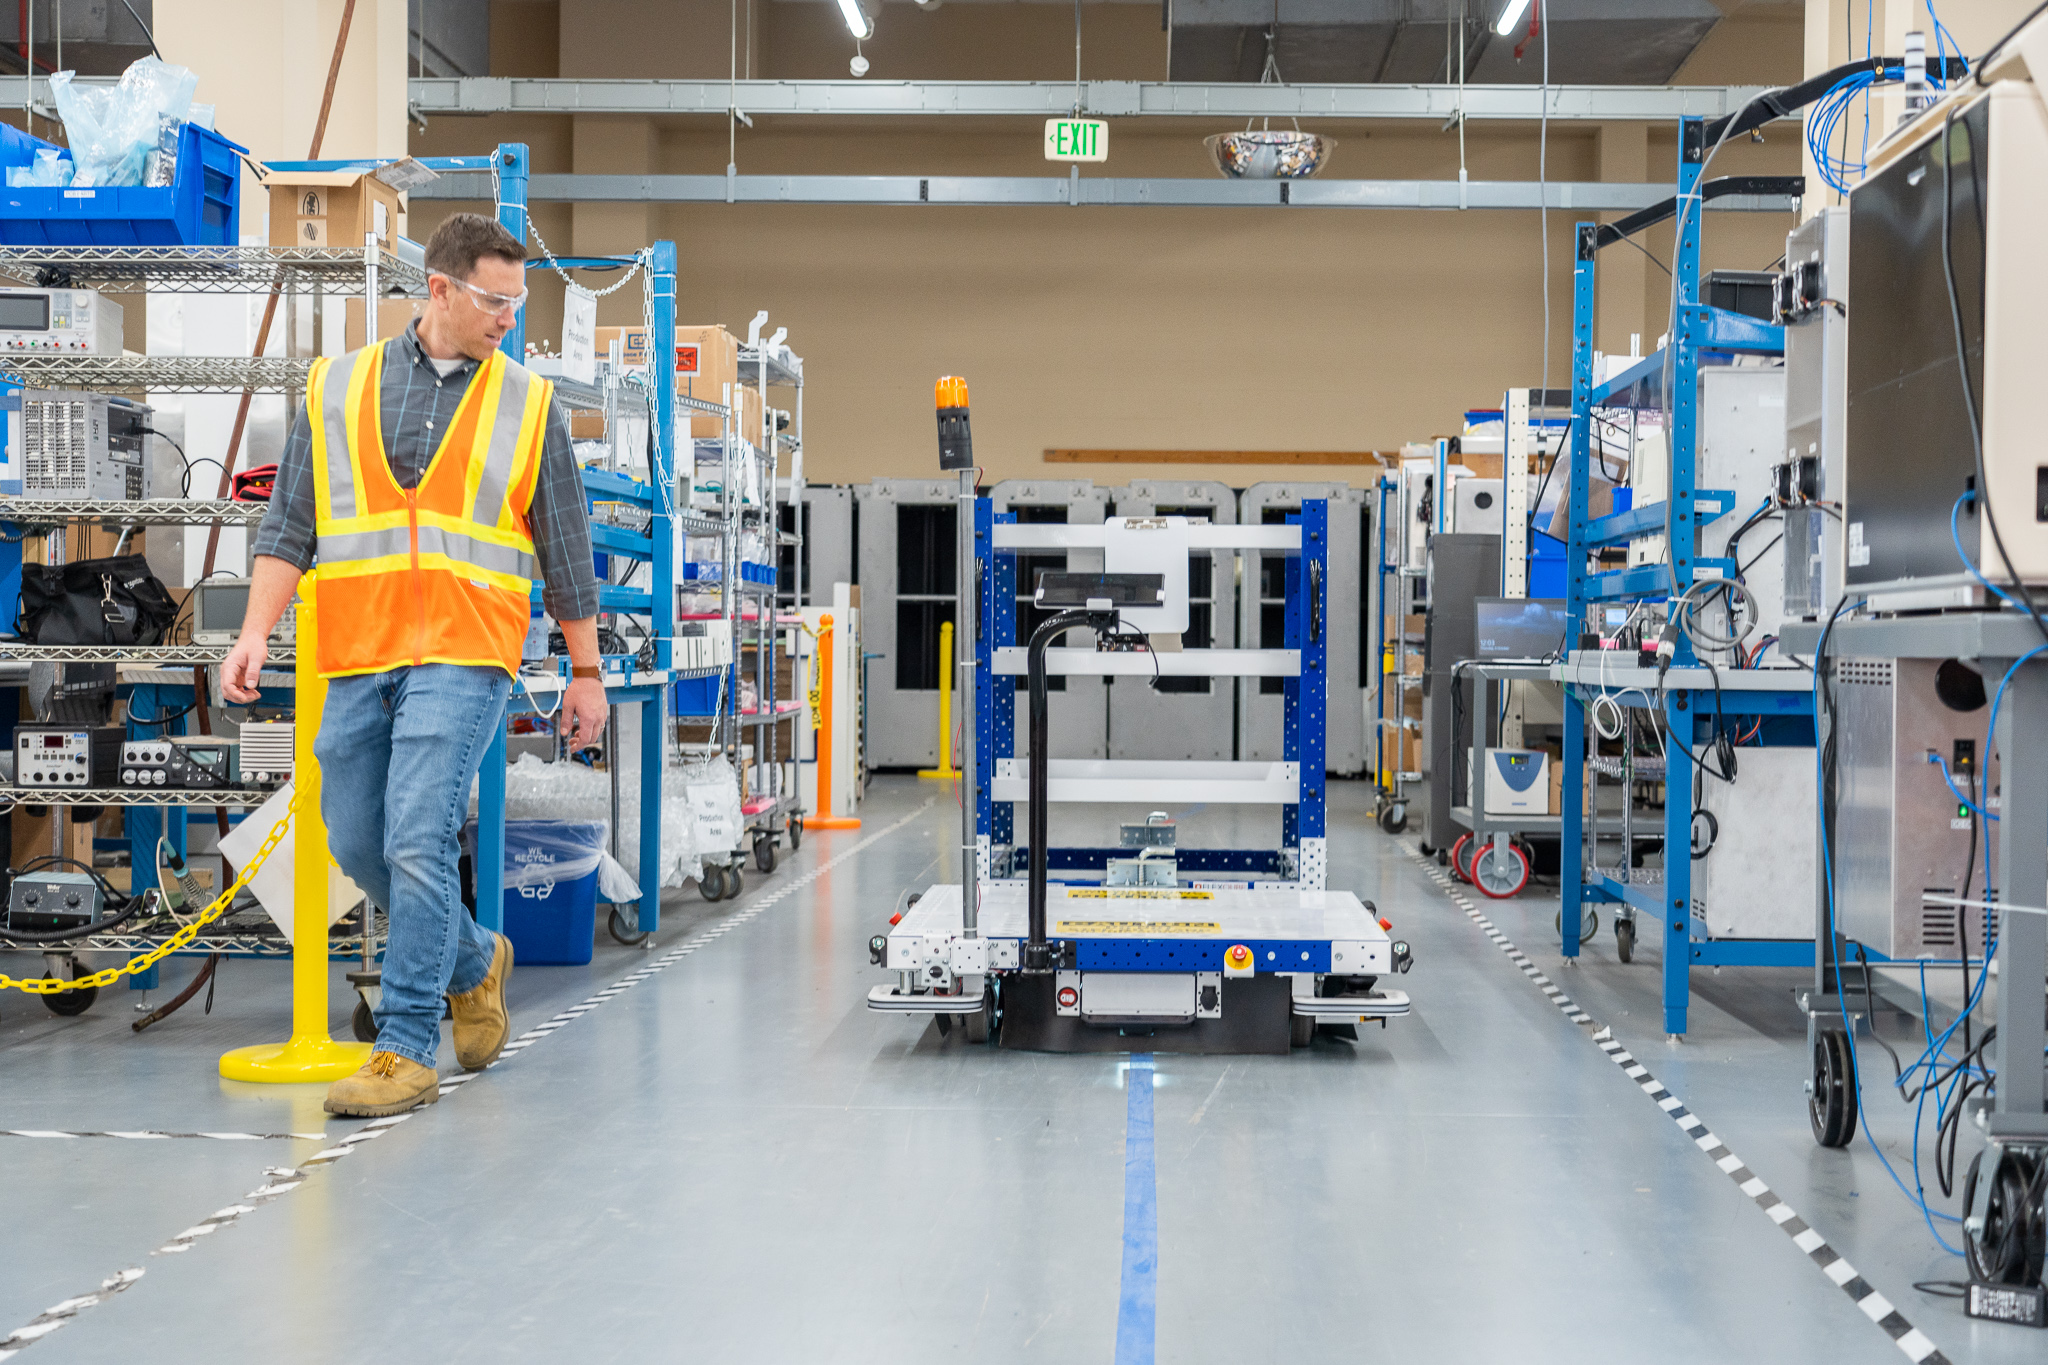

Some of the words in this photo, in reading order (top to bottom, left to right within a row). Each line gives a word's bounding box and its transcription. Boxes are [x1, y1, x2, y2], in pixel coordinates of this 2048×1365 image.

[1057, 122, 1100, 156] EXIT
[567, 328, 589, 346] Production
[710, 828, 722, 836] Area
[528, 847, 543, 855] WE
[514, 854, 556, 863] RECYCLE
